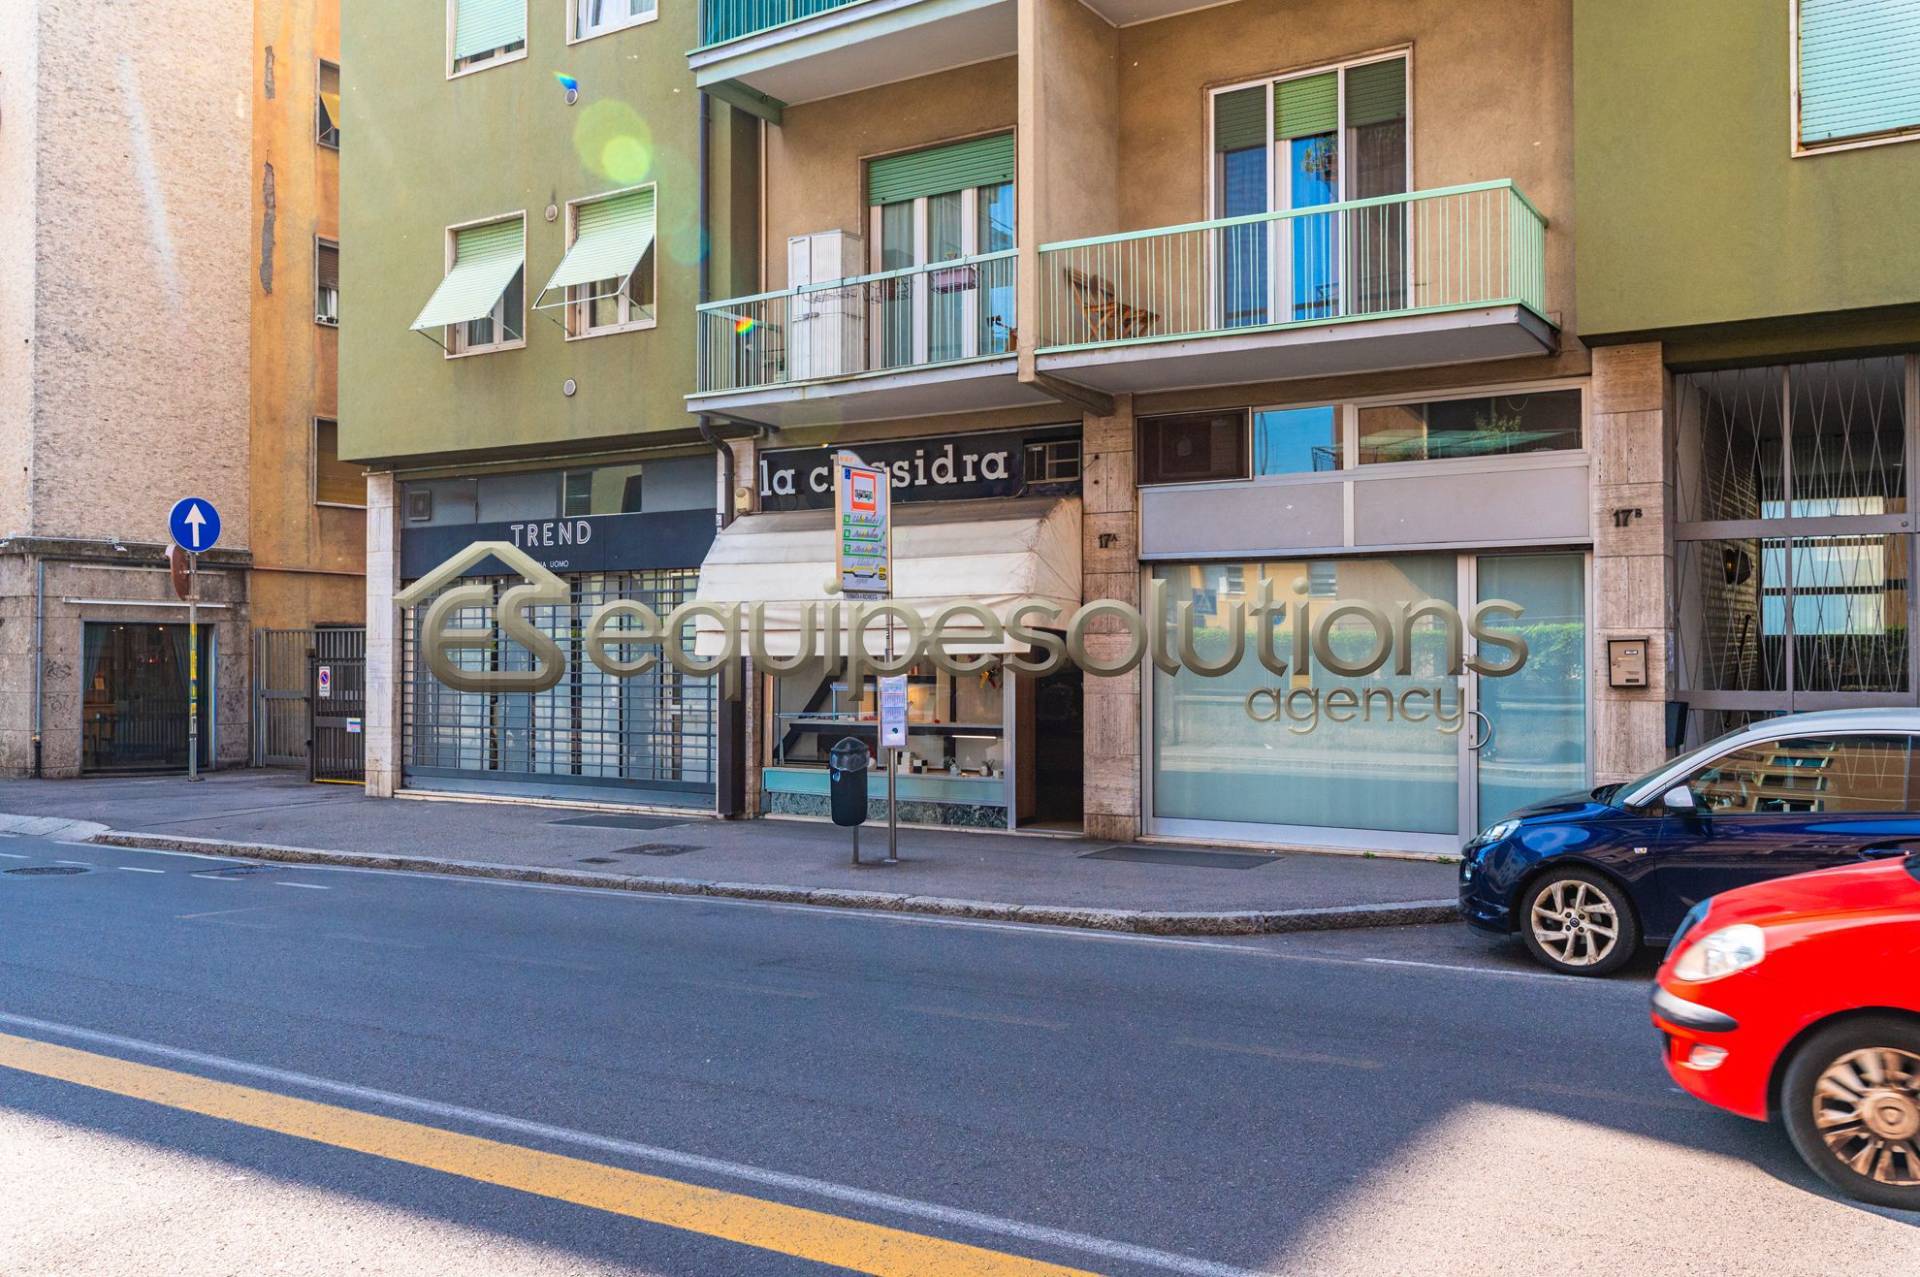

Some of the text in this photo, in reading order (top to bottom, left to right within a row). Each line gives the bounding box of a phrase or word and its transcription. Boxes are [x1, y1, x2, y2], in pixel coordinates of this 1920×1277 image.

[760, 444, 1009, 497] la csidra
[510, 520, 592, 547] TREND
[549, 559, 569, 568] UOMO
